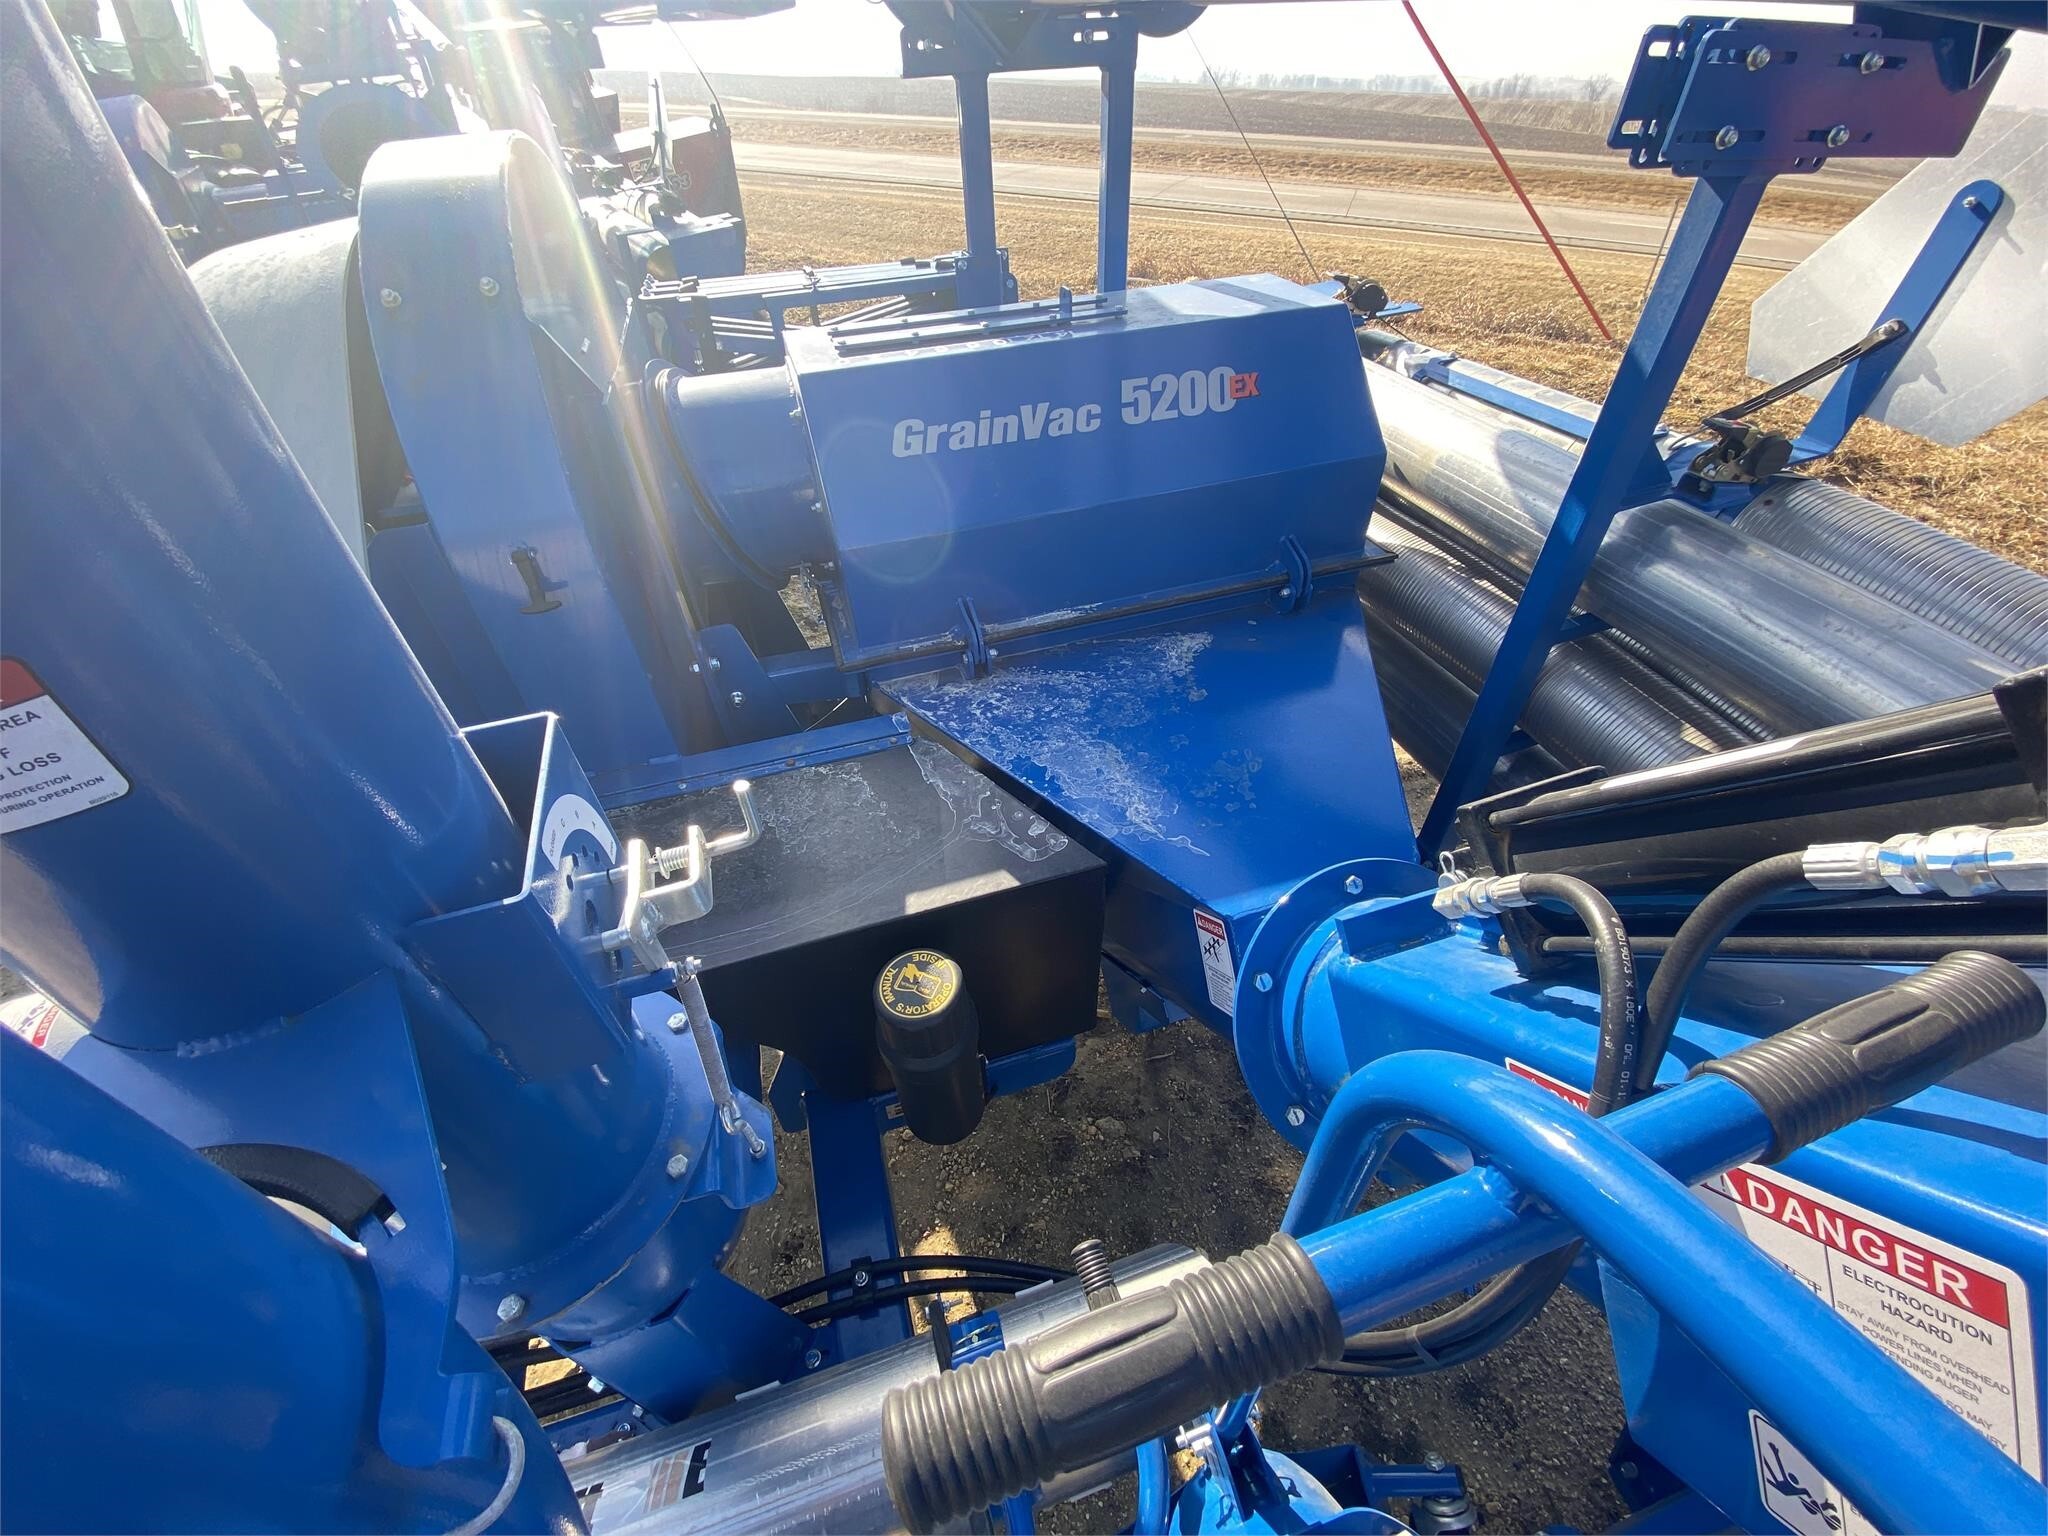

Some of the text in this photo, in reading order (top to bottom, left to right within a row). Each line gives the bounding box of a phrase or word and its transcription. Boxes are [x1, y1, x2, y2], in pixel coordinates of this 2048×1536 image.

[891, 402, 1102, 458] GrainVac
[0, 710, 42, 731] REA
[7, 752, 62, 776] LOSS
[0, 774, 73, 800] PROTECTION
[0, 776, 105, 815] URING OPERATION
[912, 953, 947, 970] INSIDE
[882, 967, 899, 1003] MANUAL
[1746, 1177, 1974, 1309] DANGER
[1842, 1264, 1993, 1346] ELECTROCUTION
[1880, 1299, 1954, 1345] HAZARD
[1837, 1301, 2011, 1396] STAY AWAY FROM OVERHEAD
[1862, 1324, 1983, 1394] POWER LINES WHEN
[1935, 1375, 1980, 1405] AUGER
[1966, 1410, 1993, 1430] MAY
